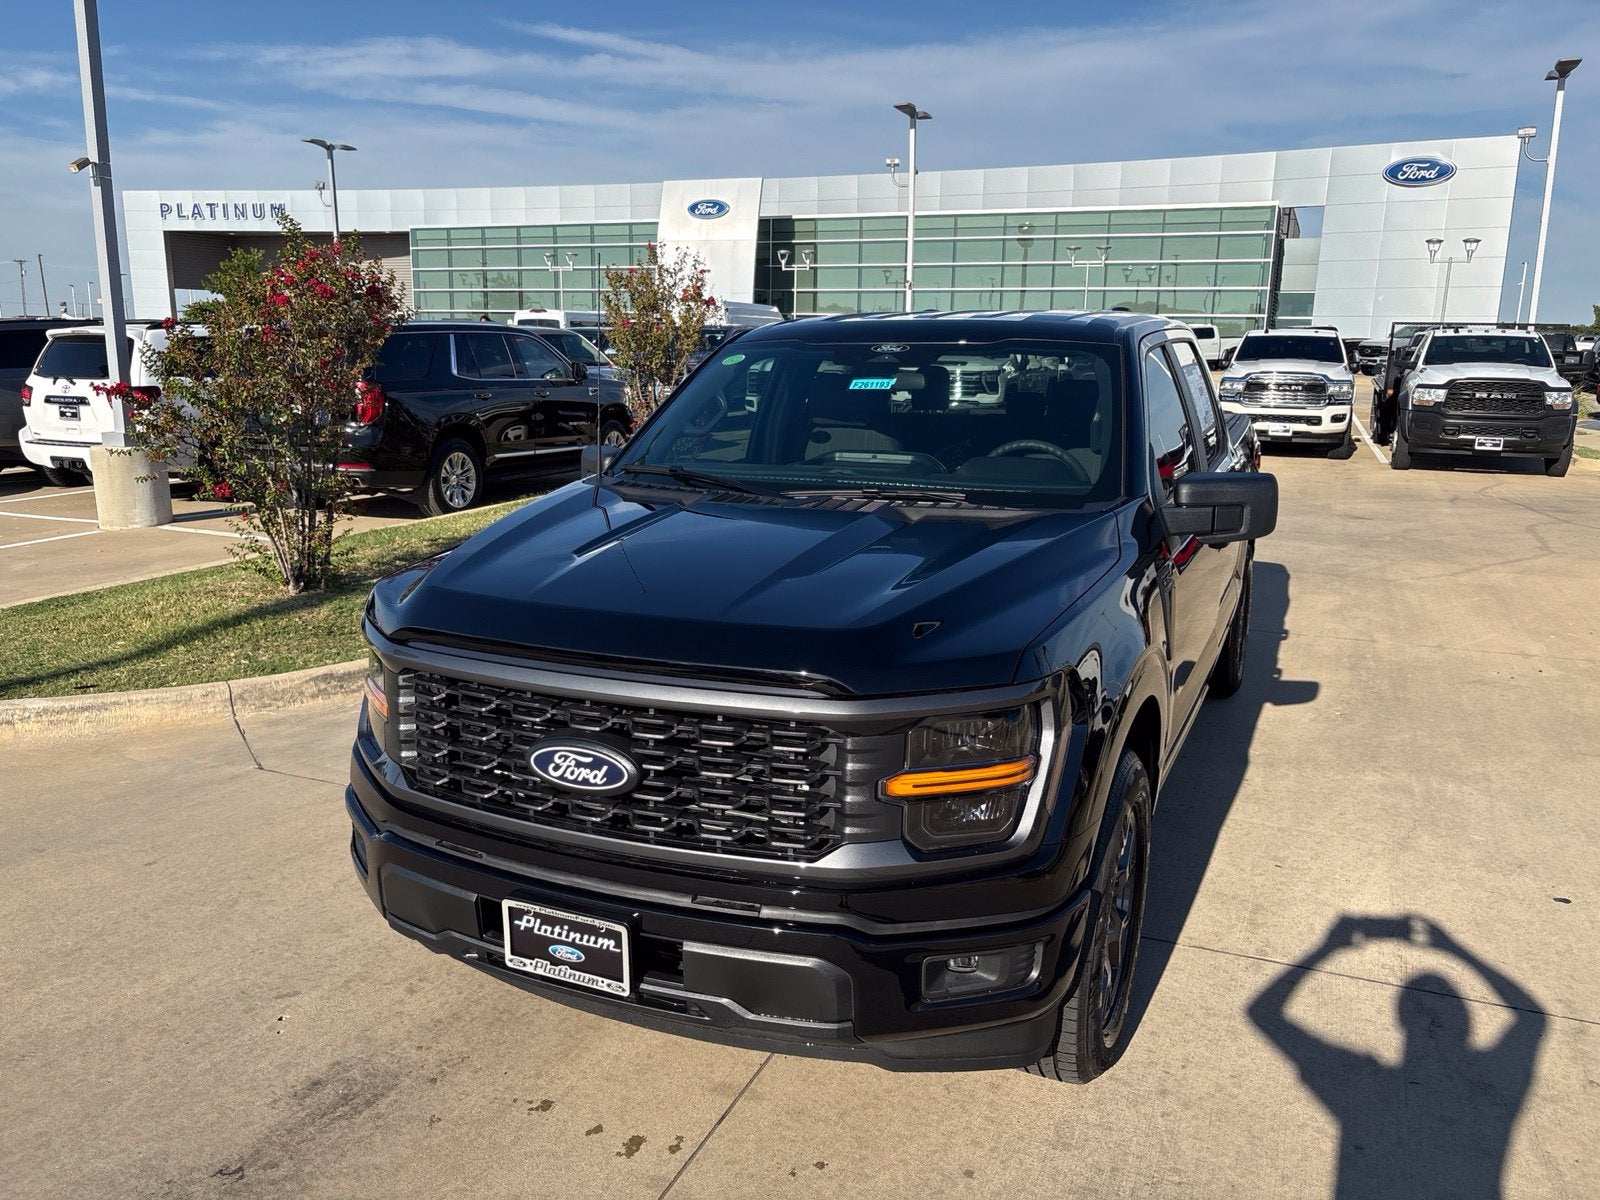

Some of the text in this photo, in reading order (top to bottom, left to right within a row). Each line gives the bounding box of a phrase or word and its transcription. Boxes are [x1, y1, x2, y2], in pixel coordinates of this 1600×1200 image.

[1397, 162, 1440, 180] Ford
[159, 202, 286, 220] PLATINUM
[694, 202, 719, 215] Ford
[852, 381, 891, 389] F261193
[548, 751, 608, 785] Ford
[514, 915, 621, 952] Platinum
[555, 947, 578, 961] Ford
[533, 960, 604, 988] Platinum
